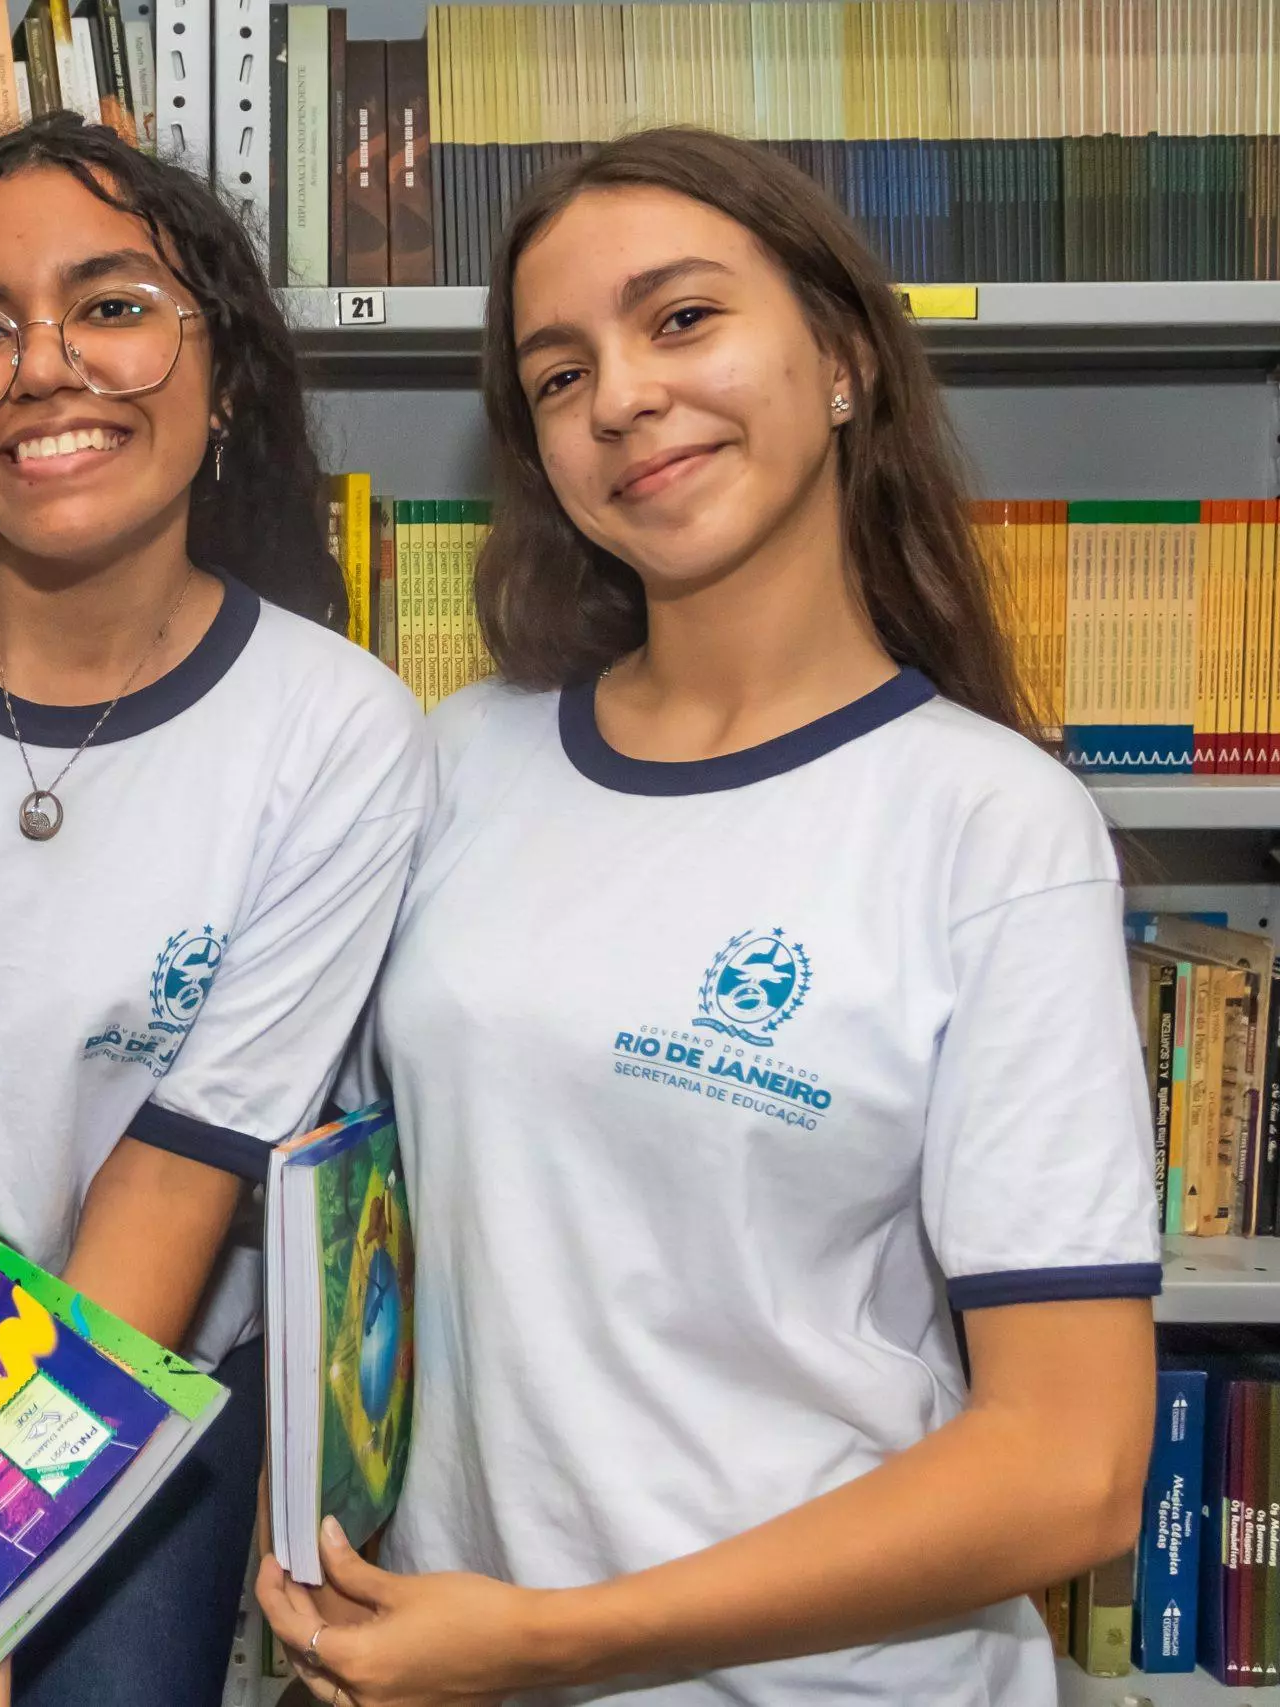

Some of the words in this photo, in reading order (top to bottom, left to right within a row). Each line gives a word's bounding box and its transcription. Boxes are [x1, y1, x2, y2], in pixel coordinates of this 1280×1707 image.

[295, 64, 307, 154] INDEPENDENTE
[296, 157, 307, 228] DIPLOMACIA
[352, 297, 374, 318] 21
[614, 1031, 661, 1058] RIO
[664, 1041, 705, 1069] DE
[708, 1055, 833, 1111] JANEIRO
[640, 1023, 715, 1049] GOVERNO
[723, 1044, 746, 1058] DO
[754, 1053, 820, 1083] ESTADO
[614, 1060, 703, 1095] SECRETARIA
[706, 1085, 729, 1103] DE
[731, 1093, 818, 1132] EDUCAÇÃO
[1156, 1086, 1169, 1127] biografia
[1156, 1127, 1167, 1148] Uma
[69, 1425, 98, 1455] PNLD
[1170, 1474, 1186, 1521] Música
[1156, 1500, 1171, 1549] Escolas
[1168, 1522, 1183, 1576] Clássica
[1268, 1518, 1280, 1567] Modernos
